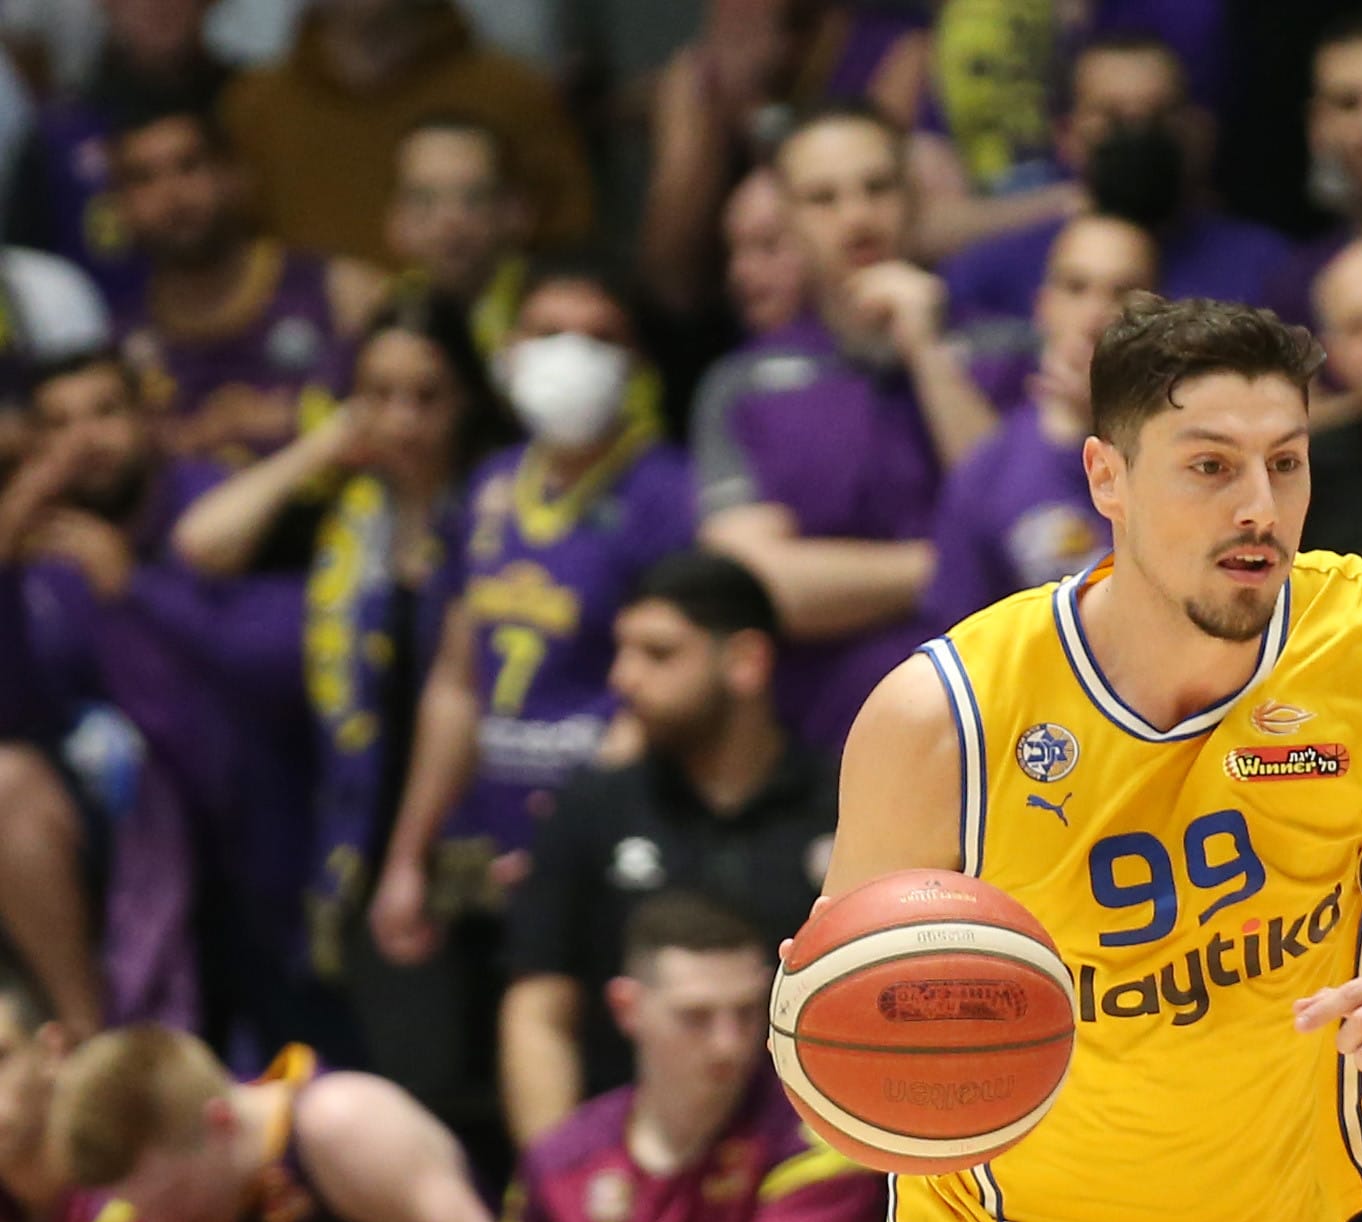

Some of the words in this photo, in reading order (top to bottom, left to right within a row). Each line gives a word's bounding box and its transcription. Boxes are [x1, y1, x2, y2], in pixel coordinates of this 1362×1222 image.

[1236, 757, 1317, 776] Winner
[1288, 747, 1317, 762] ליגת
[1318, 757, 1338, 773] סל
[1087, 808, 1267, 948] 99
[1066, 882, 1343, 1027] laytika
[881, 1075, 1016, 1111] molten
